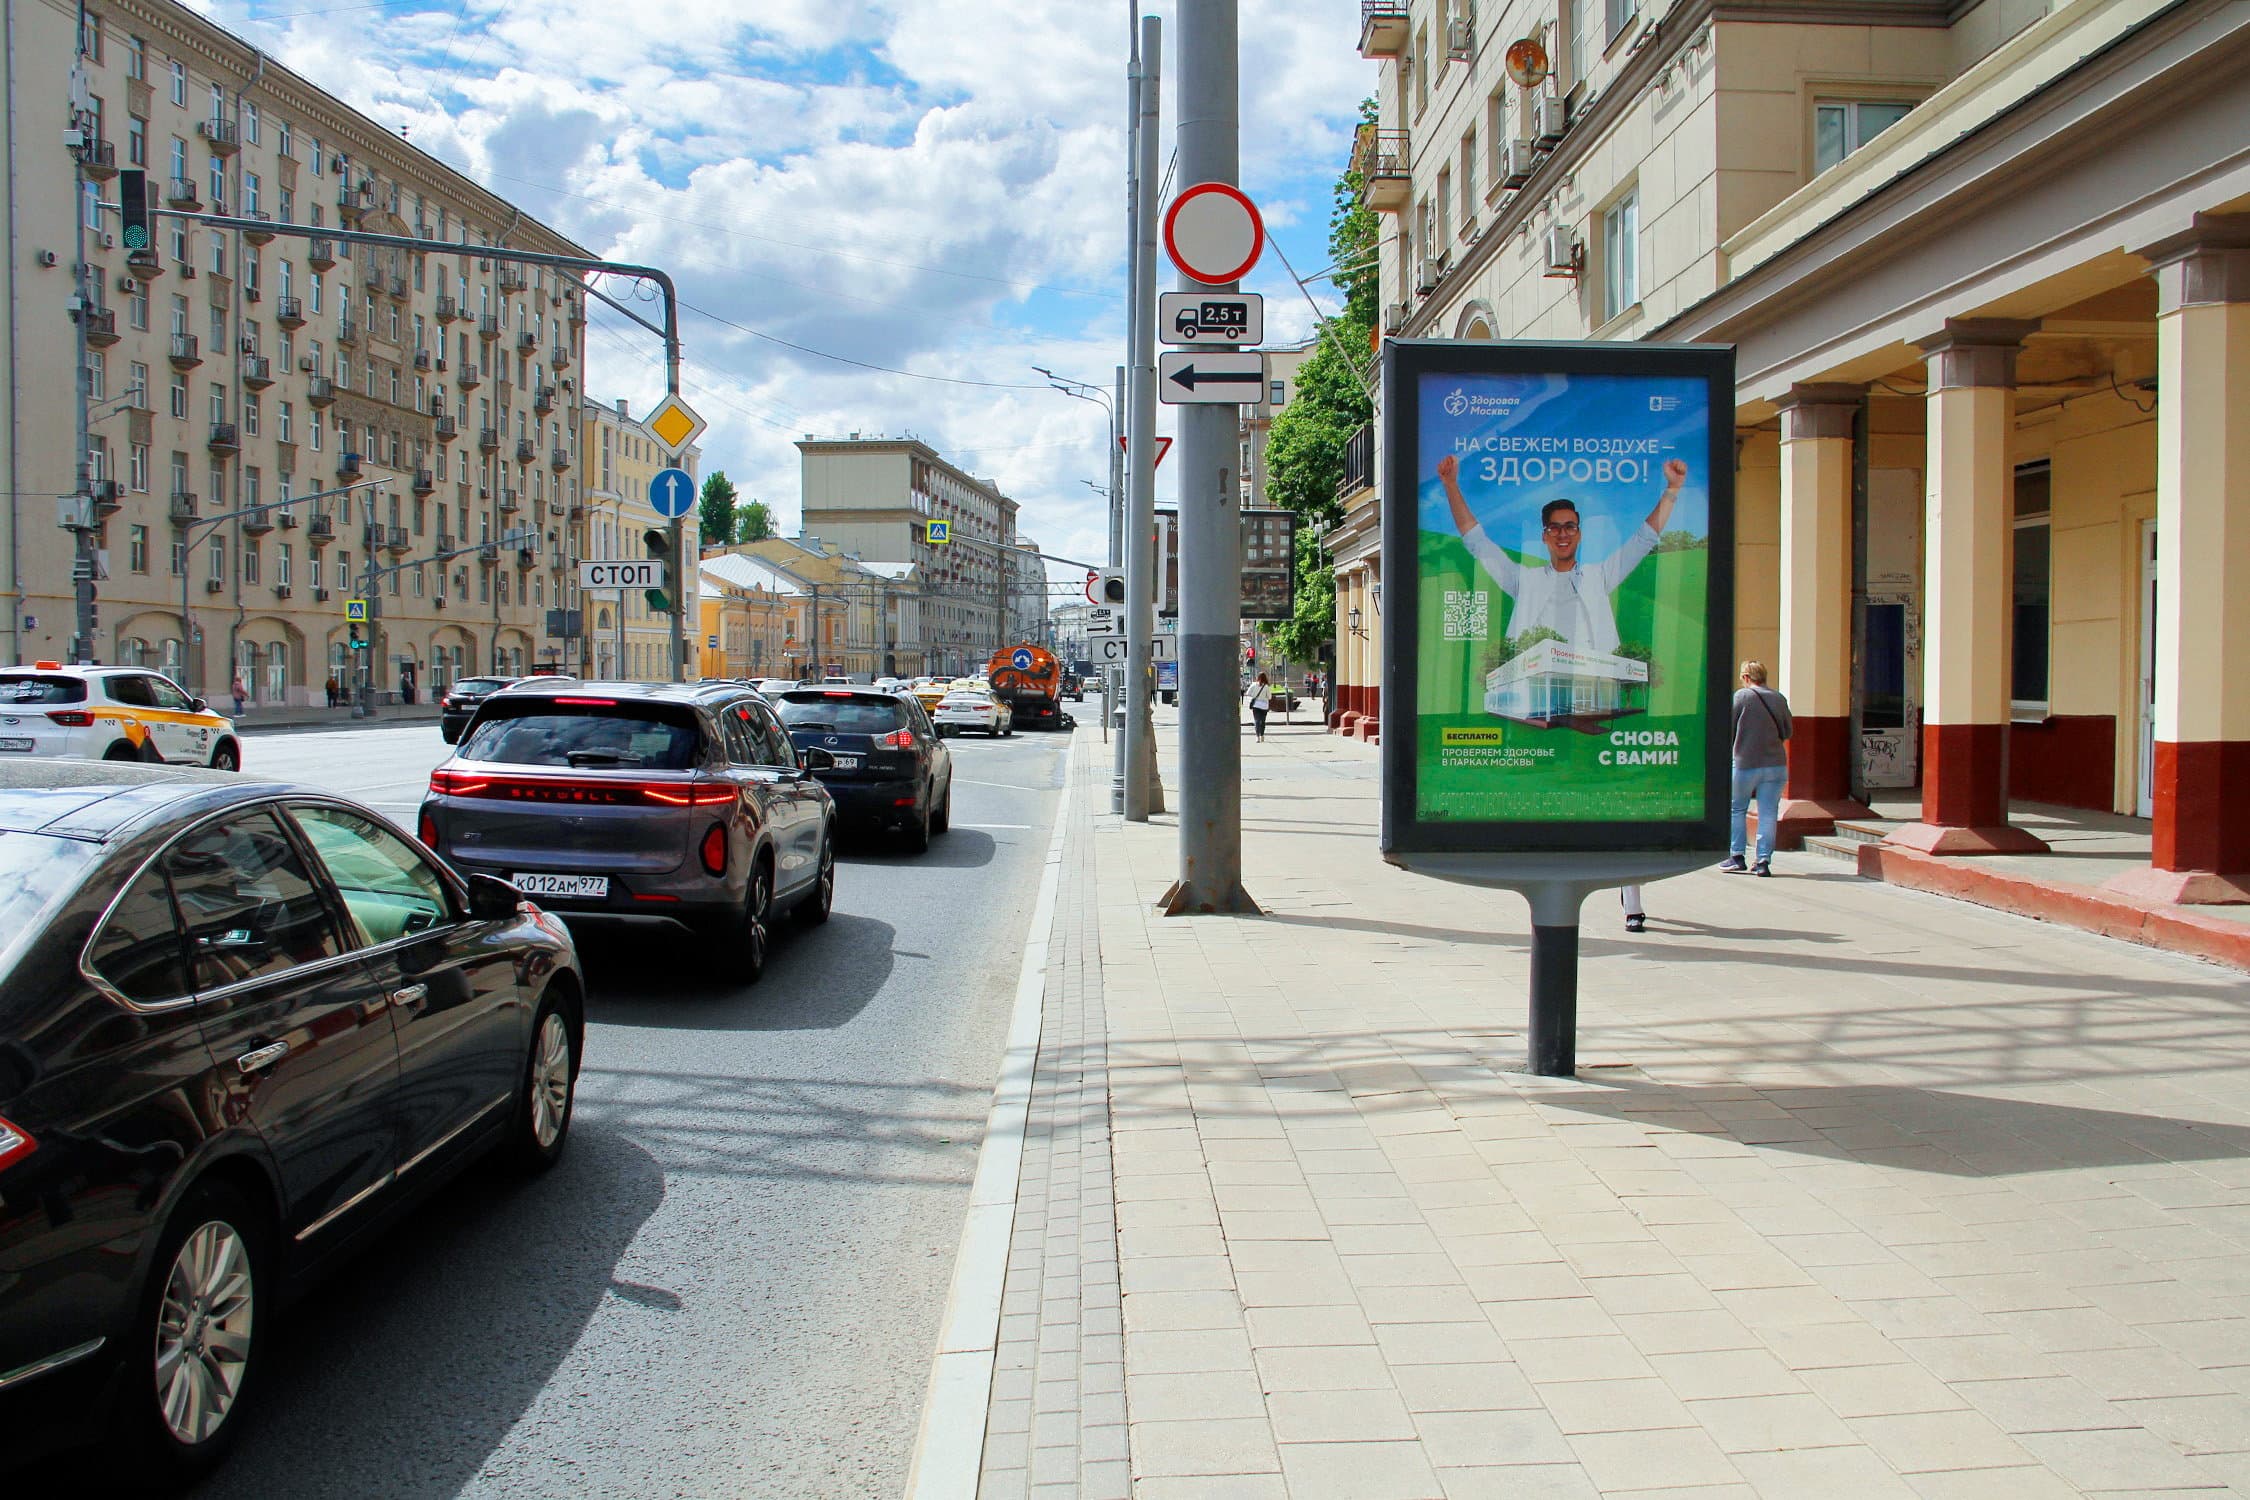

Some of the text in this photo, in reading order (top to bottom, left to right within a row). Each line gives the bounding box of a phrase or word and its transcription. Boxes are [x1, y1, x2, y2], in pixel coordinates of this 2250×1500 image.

[1206, 307, 1229, 323] 2,5
[1470, 395, 1520, 408] Здоровая
[1470, 406, 1510, 416] Москва
[1455, 437, 1481, 452] НА
[1485, 437, 1569, 453] СВЕЖЕМ
[1573, 438, 1659, 456] ВОЗДУХЕ
[1479, 457, 1649, 486] ЗДОРОВО!
[591, 566, 651, 584] СТОП
[1104, 640, 1164, 659] СТП
[1447, 733, 1498, 741] БЕСПЛАТНО
[1610, 731, 1679, 746] СНОВА
[1442, 748, 1555, 759] ПРОВЕРЯЕМ ЗДОРОВЬЕ
[1599, 750, 1678, 766] С ВАМИ!
[1442, 758, 1534, 767] В ПАРКАХ МОСКВЫ
[511, 789, 616, 801] SKYWELL
[580, 877, 604, 890] 977
